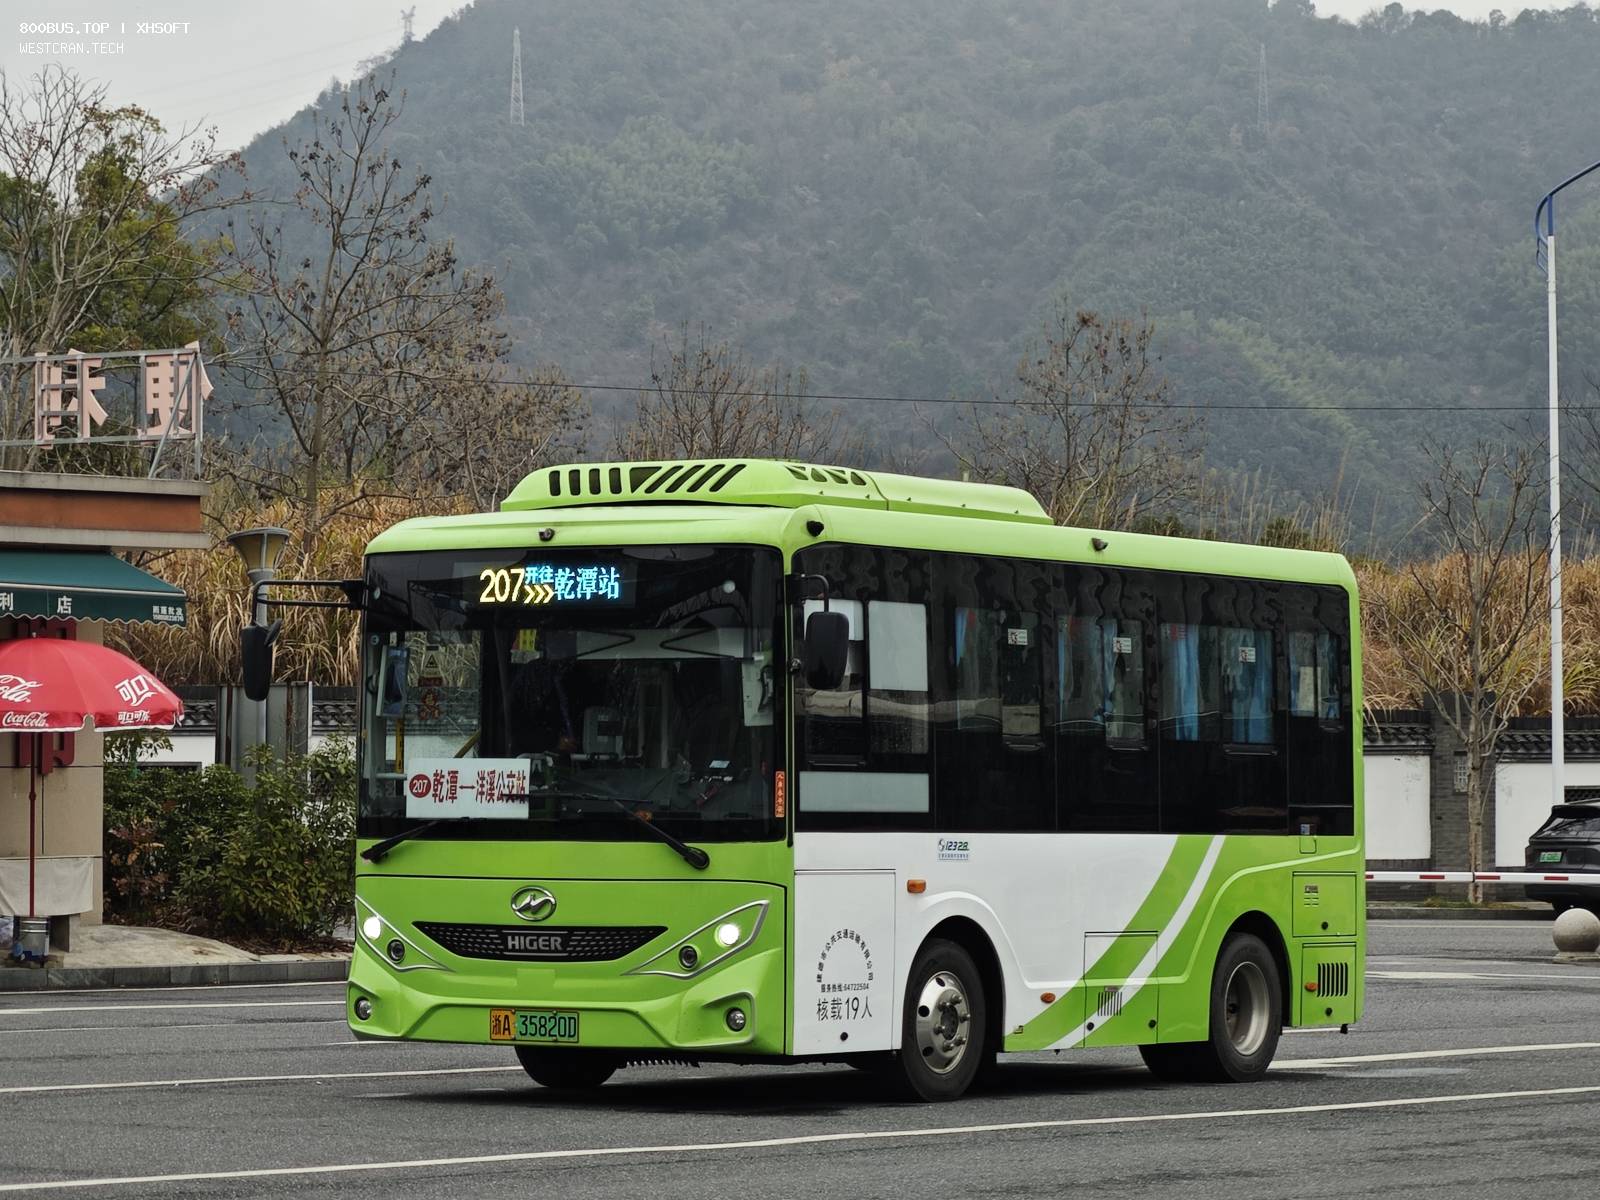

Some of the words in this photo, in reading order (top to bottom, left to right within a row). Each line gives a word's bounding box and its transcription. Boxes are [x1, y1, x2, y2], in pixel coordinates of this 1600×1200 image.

[479, 568, 525, 603] 207
[525, 566, 555, 584] 开往
[554, 567, 620, 601] 乾潭站
[117, 710, 150, 724] 可口可乐
[412, 779, 428, 793] 207
[432, 769, 459, 804] 乾潭
[476, 769, 526, 804] 洋溪公交站
[507, 935, 563, 951] HIGER
[817, 996, 872, 1021] 核载19人
[491, 1014, 511, 1036] 浙A
[519, 1014, 577, 1038] 35820D
